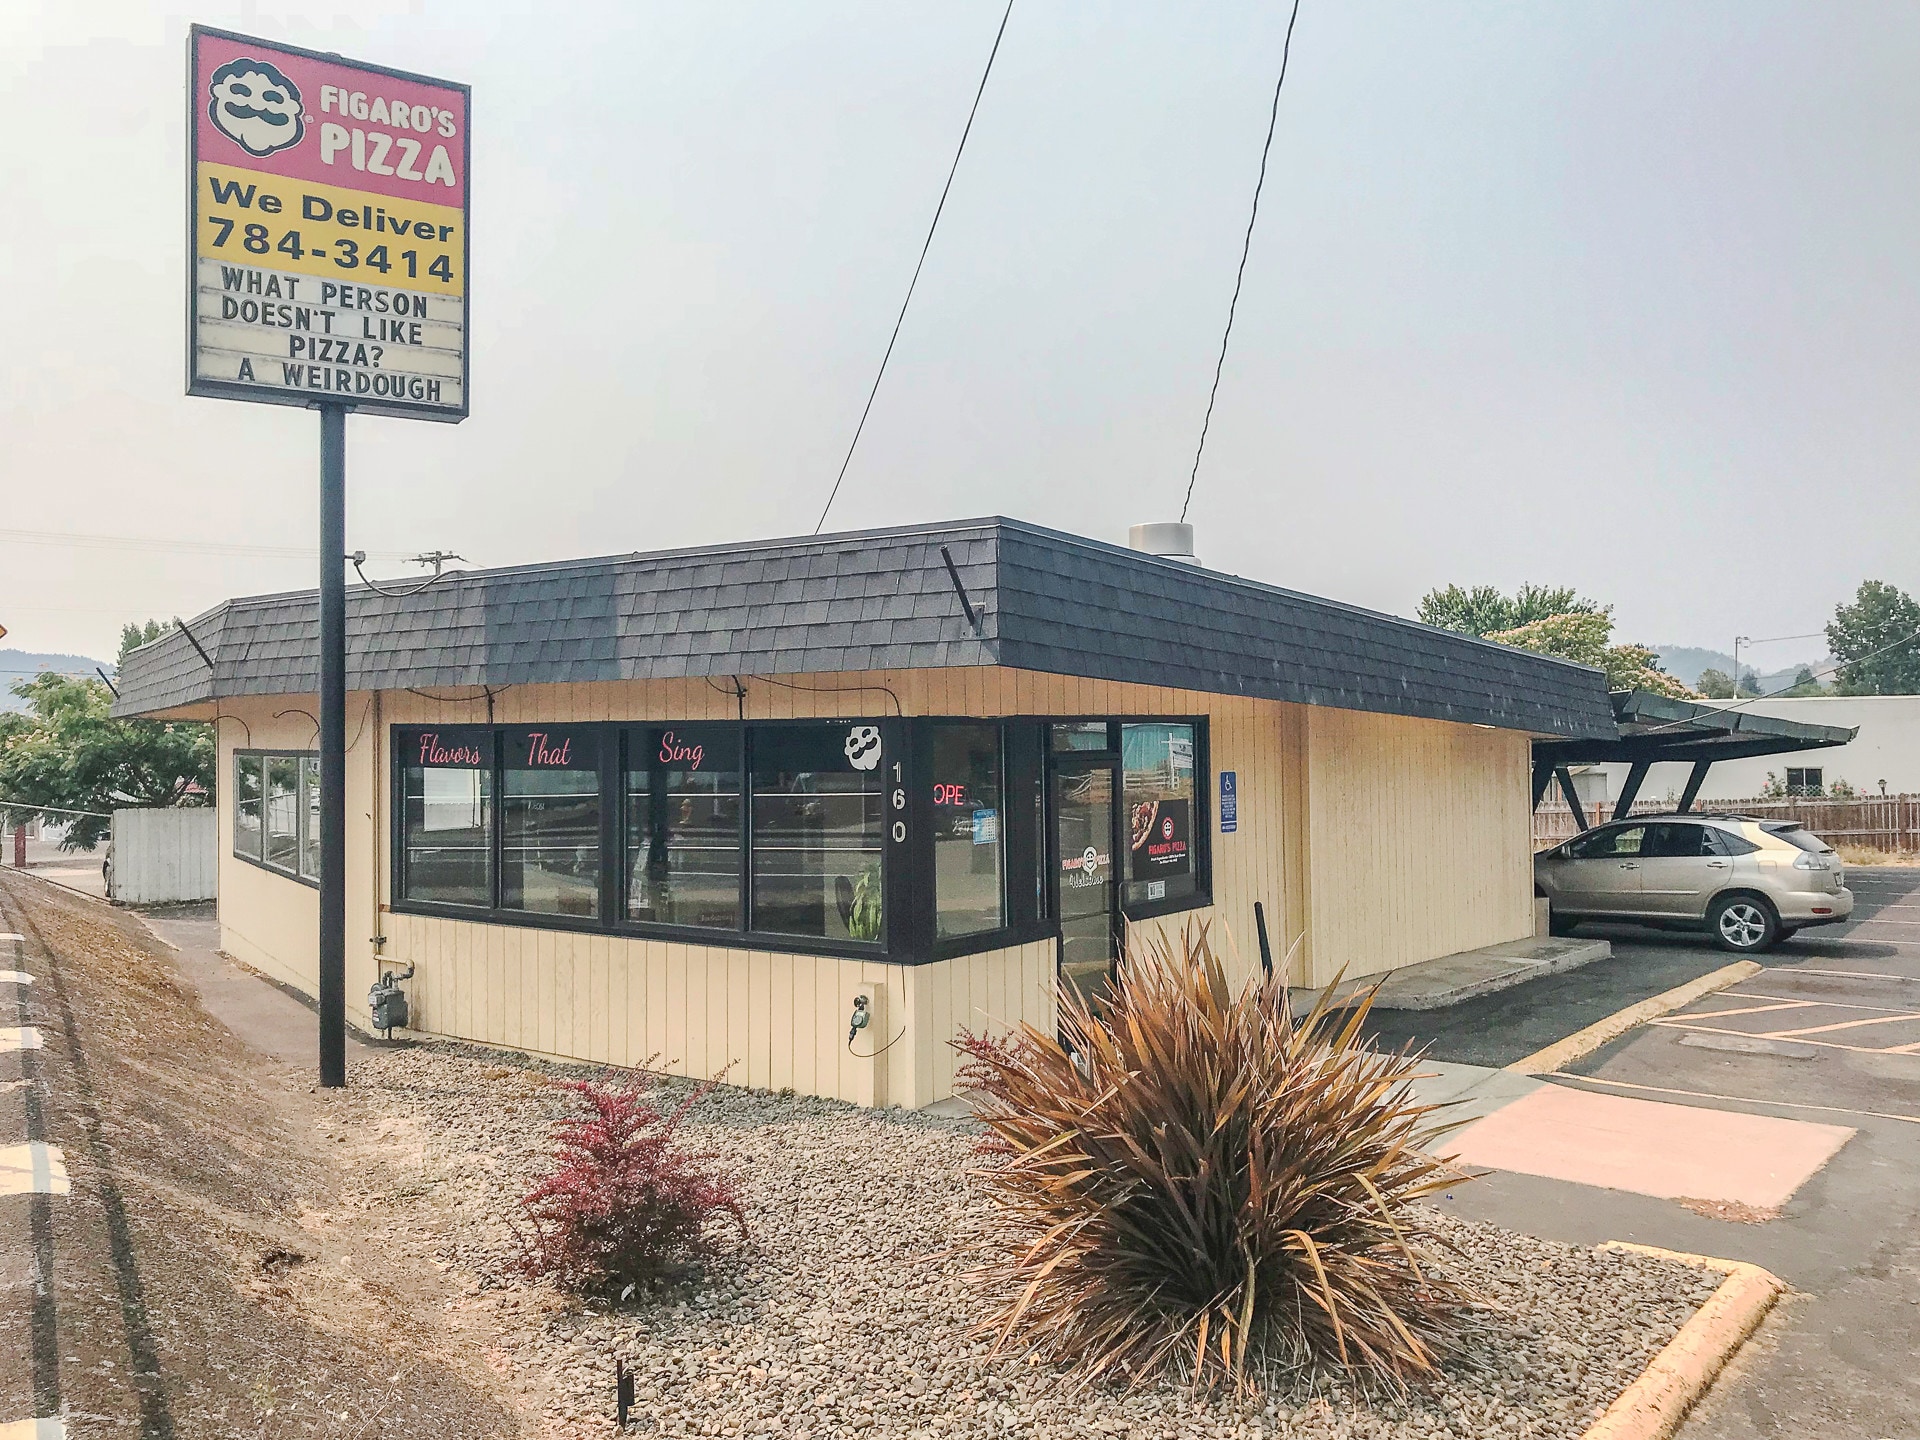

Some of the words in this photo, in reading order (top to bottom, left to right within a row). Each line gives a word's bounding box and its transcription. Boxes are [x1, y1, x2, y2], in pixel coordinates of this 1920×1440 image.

[320, 84, 457, 138] FIGARO'S
[320, 122, 457, 187] PIZZA
[209, 176, 283, 214] We
[302, 194, 455, 243] Deliver
[208, 215, 455, 284] 784-3414
[220, 265, 300, 300] WHAT
[321, 281, 428, 319] PERSON
[221, 295, 336, 334] DOESN'T
[363, 316, 423, 346] LIKE
[289, 334, 384, 368] PIZZA?
[238, 357, 255, 382] A
[282, 362, 442, 402] WEIRDOUGH
[419, 732, 482, 765] Flavors
[527, 732, 572, 767] That
[659, 731, 705, 771] Sing
